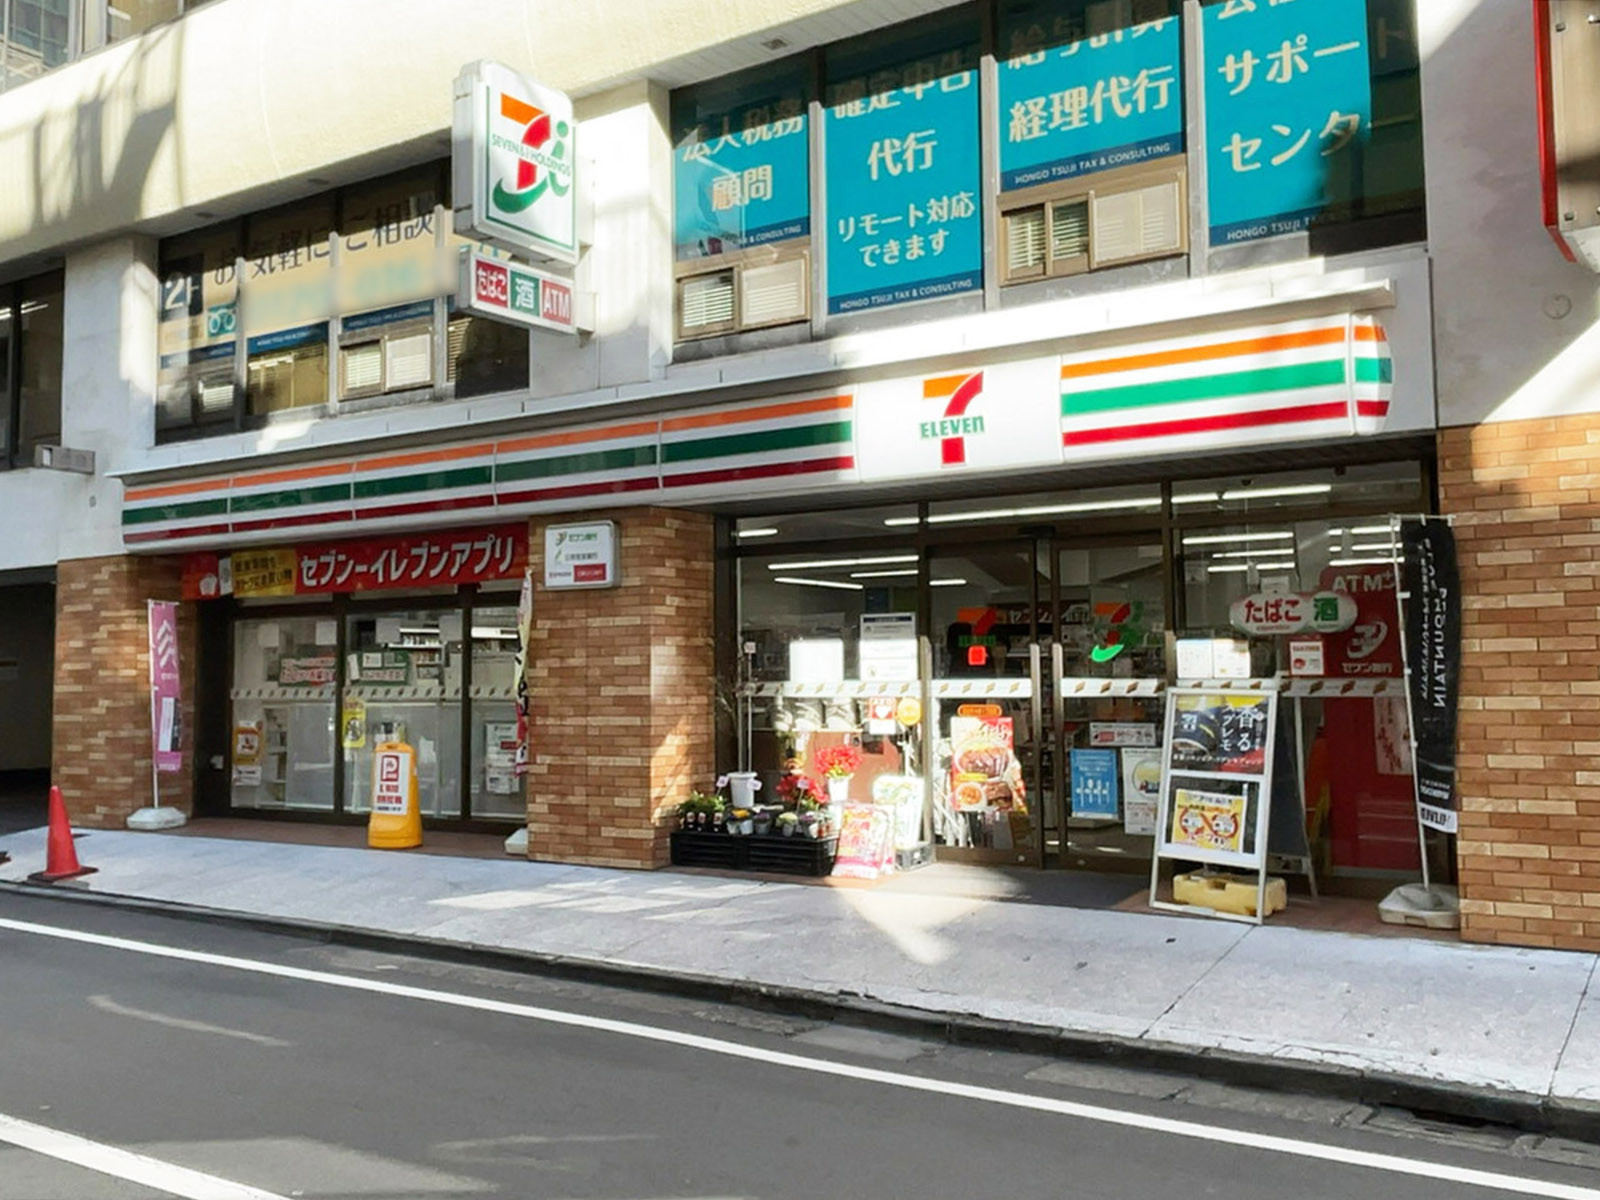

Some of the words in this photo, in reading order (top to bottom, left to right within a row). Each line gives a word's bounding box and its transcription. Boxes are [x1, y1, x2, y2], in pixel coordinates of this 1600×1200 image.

[1008, 65, 1175, 143] 経理代行
[867, 130, 937, 182] 代行
[1015, 171, 1049, 184] HONGO
[1052, 164, 1077, 177] TSUJI
[1079, 161, 1098, 171] TAX
[1100, 158, 1106, 166] &
[1108, 143, 1170, 165] CONSULTING
[712, 165, 773, 212] 顧問
[756, 225, 802, 242] CONSULTING
[838, 191, 976, 242] リモート対応
[1227, 226, 1267, 240] HONGO
[1271, 219, 1300, 232] TSUJI
[859, 229, 950, 268] できます
[477, 268, 507, 300] たばこ
[517, 277, 535, 310] 酒
[544, 287, 570, 318] ATM
[840, 298, 869, 310] HONGO
[871, 292, 893, 304] TSUJI
[895, 290, 911, 299] TAX
[920, 279, 972, 296] CONSULTING
[1333, 574, 1382, 593] ATM
[1244, 599, 1302, 623] たばこ
[1313, 597, 1338, 622] 酒
